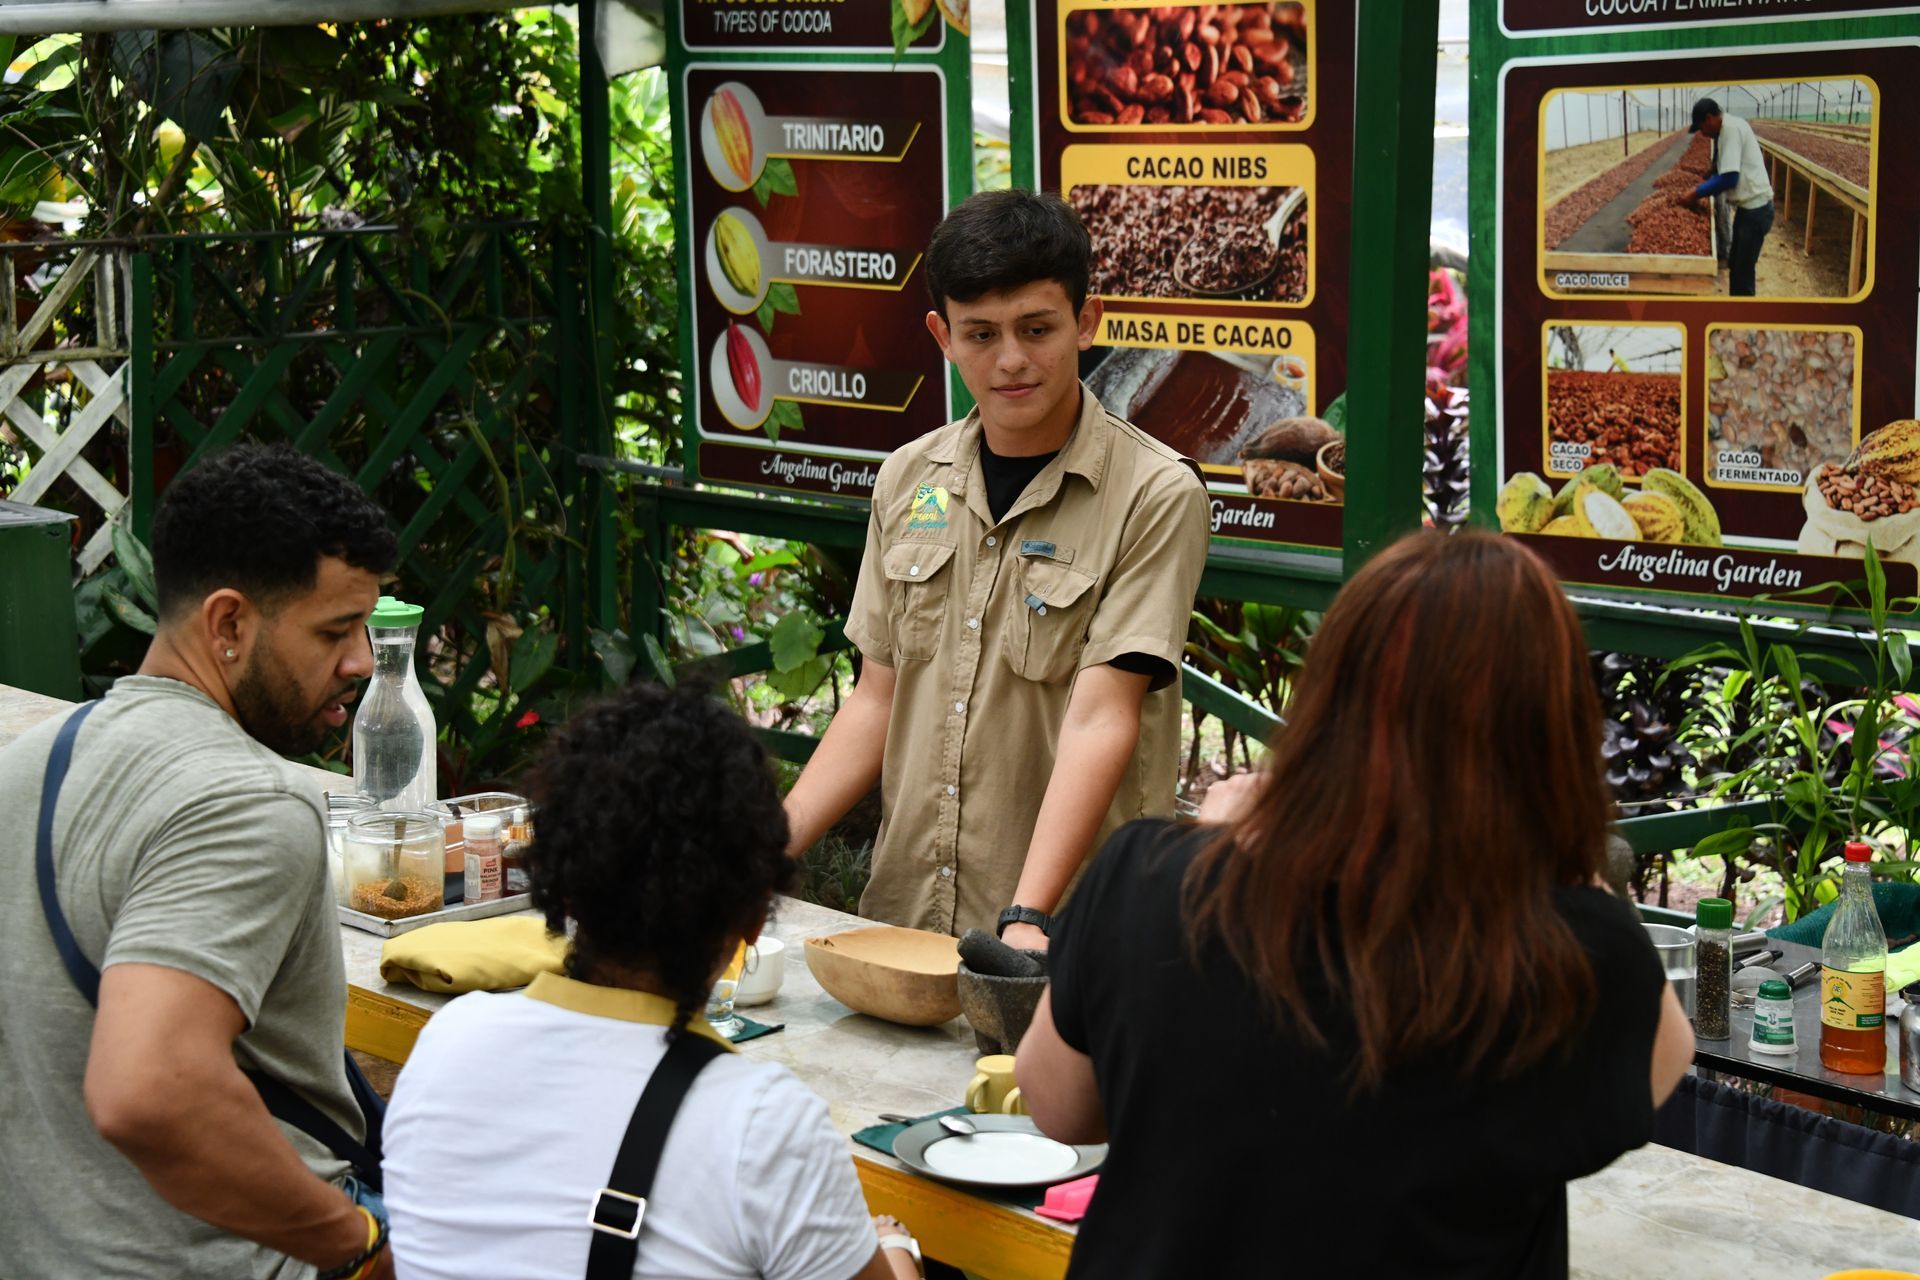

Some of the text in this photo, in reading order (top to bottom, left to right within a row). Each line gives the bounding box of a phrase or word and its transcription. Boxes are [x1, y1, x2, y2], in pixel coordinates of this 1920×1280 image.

[714, 10, 832, 33] TYPES OF COCOA
[783, 123, 884, 153] TRINITARIO
[1126, 156, 1268, 179] CACAO NIBS
[784, 248, 897, 280] FORASTERO
[1556, 274, 1628, 287] CACO DULCE
[1107, 319, 1292, 349] MASA DE CACAO
[788, 367, 867, 399] CRIOLLO
[1552, 444, 1590, 456] CACAO
[1719, 453, 1760, 465] CACAO
[761, 454, 878, 492] Angelina Garde
[1552, 459, 1582, 470] SECO
[1718, 468, 1800, 484] FERMENTADO
[1210, 499, 1275, 532] Garden
[1598, 544, 1802, 592] Angelina Garden
